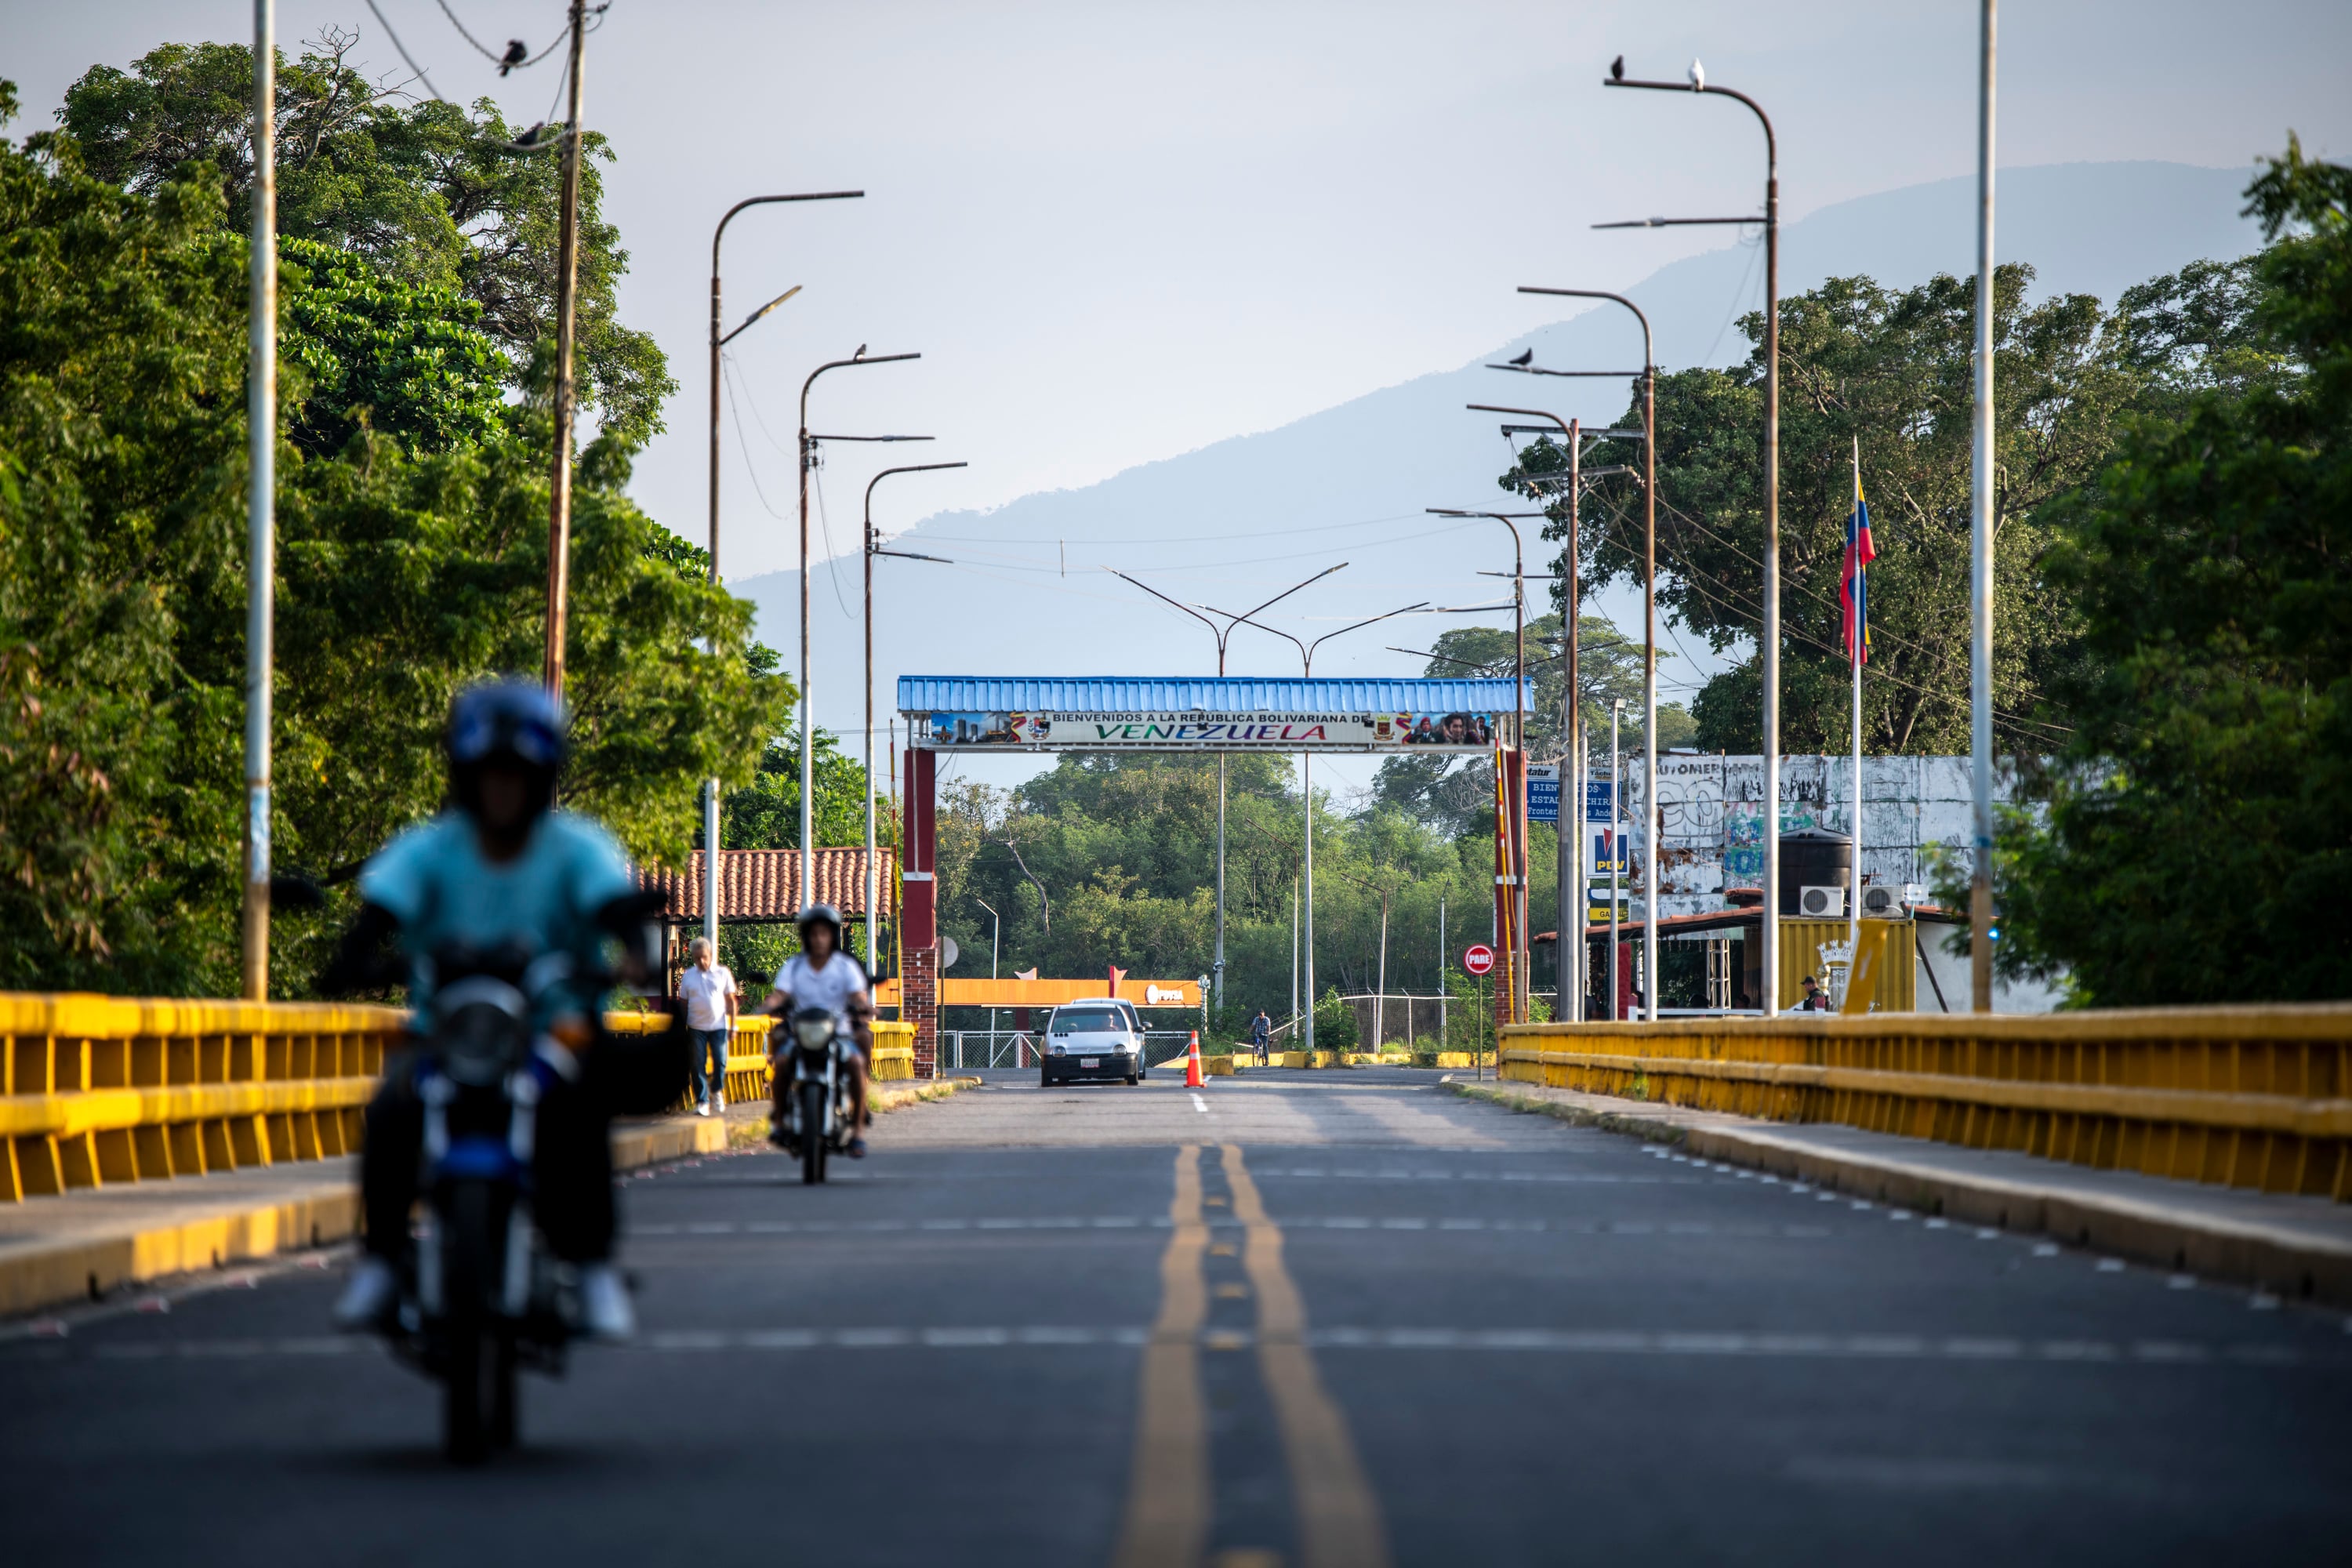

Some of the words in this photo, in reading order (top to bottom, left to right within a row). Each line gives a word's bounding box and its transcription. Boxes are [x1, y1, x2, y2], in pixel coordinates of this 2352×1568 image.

[1053, 713, 1142, 722] BIENVENIDOS
[1180, 712, 1254, 722] REPÚBLICA
[1258, 714, 1348, 723] BOLIVARIANA
[1352, 715, 1369, 724] DE
[1095, 724, 1327, 740] VENEZUELA
[1469, 954, 1490, 964] PARE
